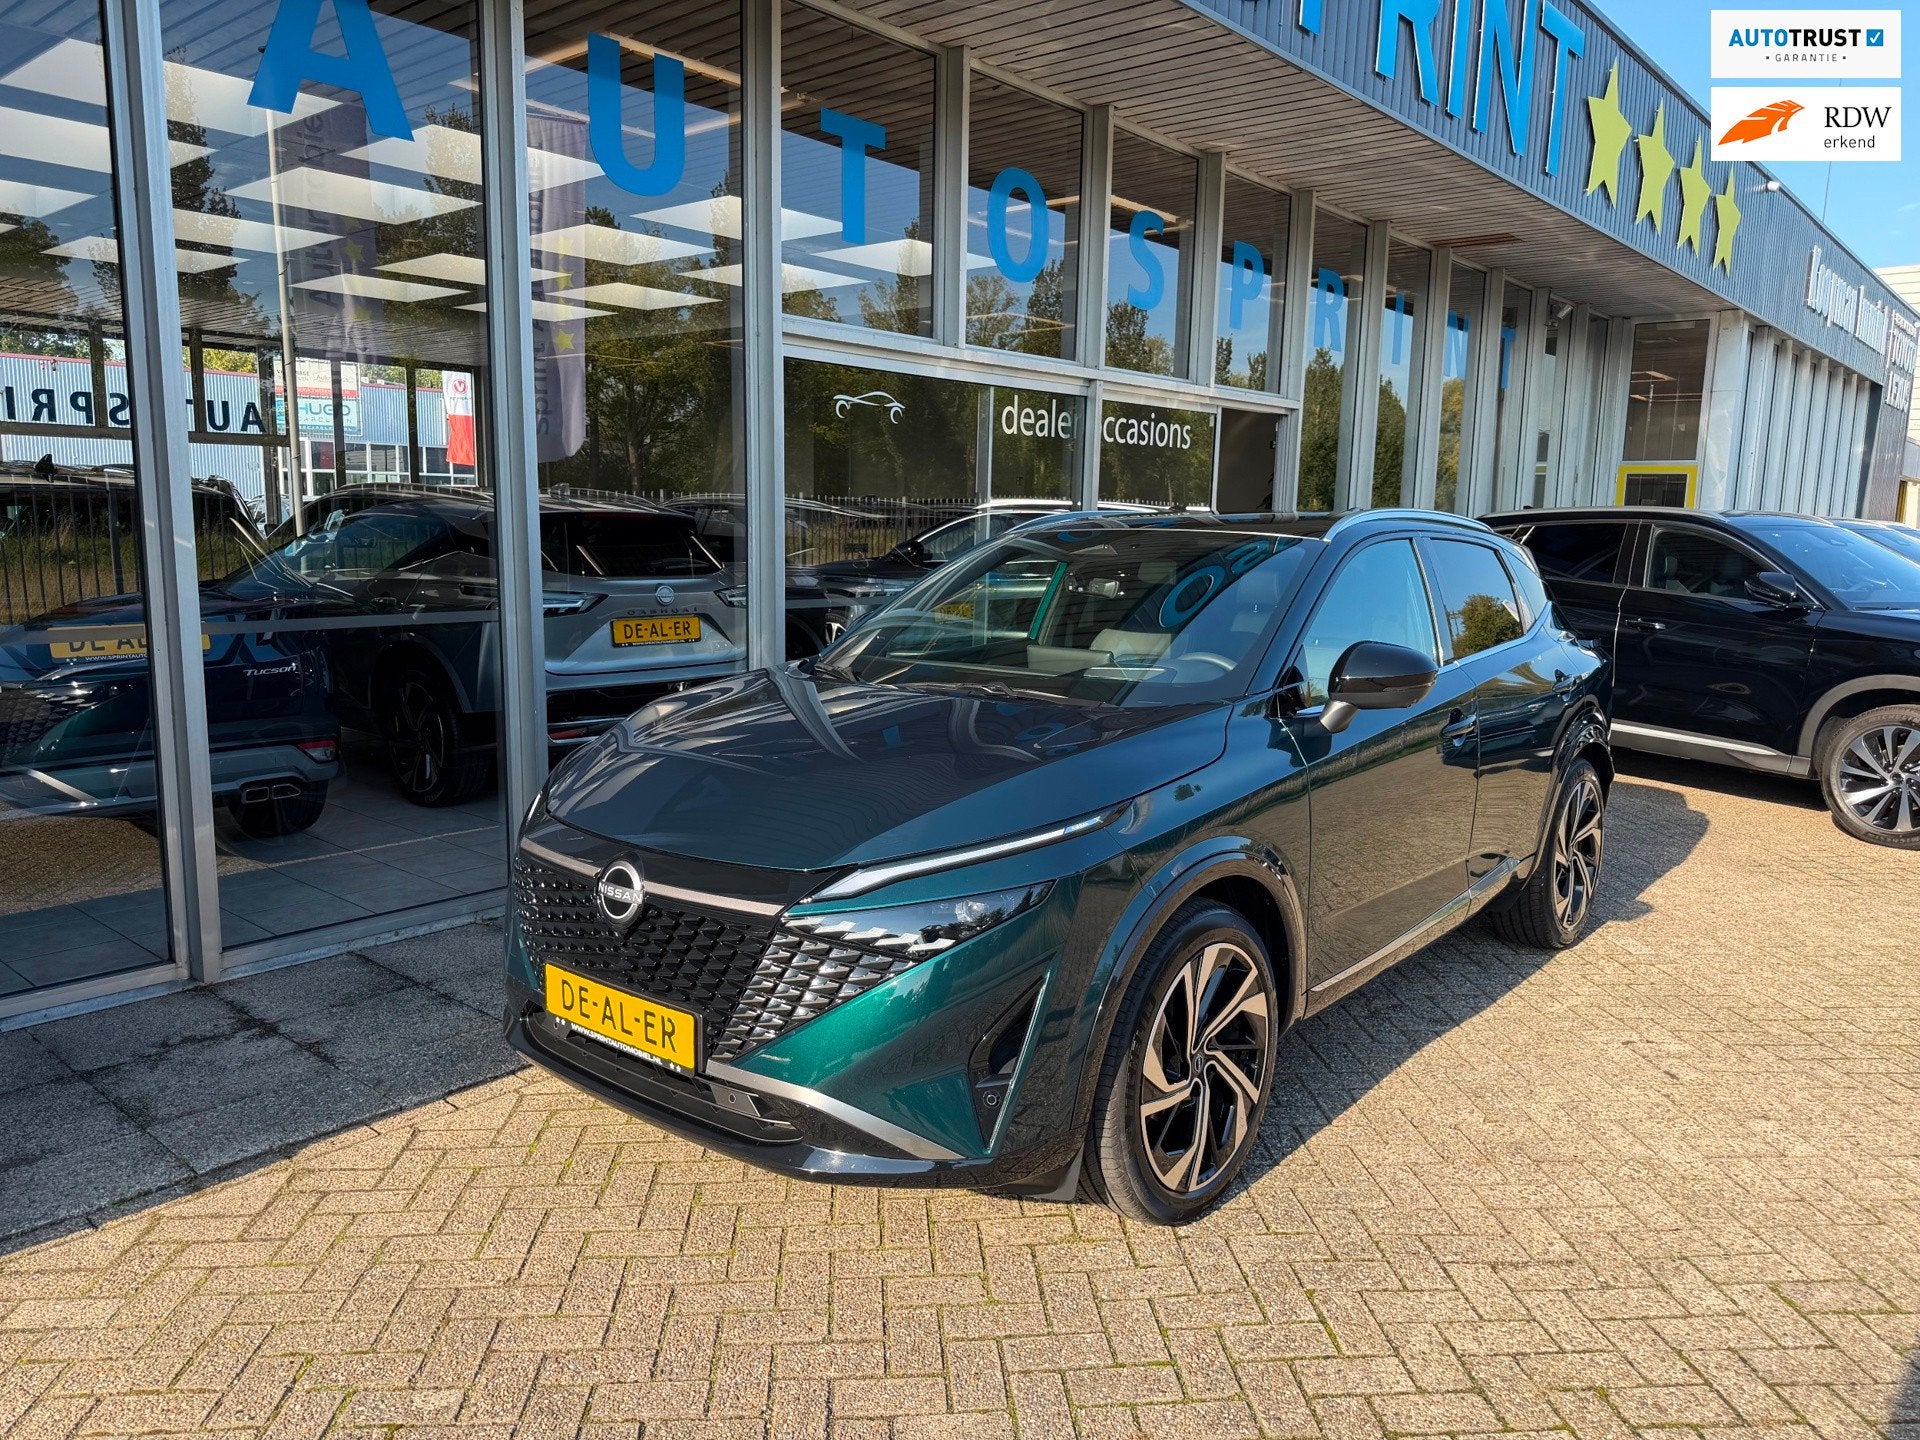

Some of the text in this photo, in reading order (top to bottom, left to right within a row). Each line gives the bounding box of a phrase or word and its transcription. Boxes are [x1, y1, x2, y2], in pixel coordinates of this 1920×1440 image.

[1101, 413, 1191, 449] ccasions
[623, 620, 691, 640] DE-AL-ER
[598, 882, 643, 905] NISSAN
[561, 979, 677, 1053] DE-AL-ER
[570, 1022, 663, 1067] WWW.SPRINTAUTOMOBIEL.NL
